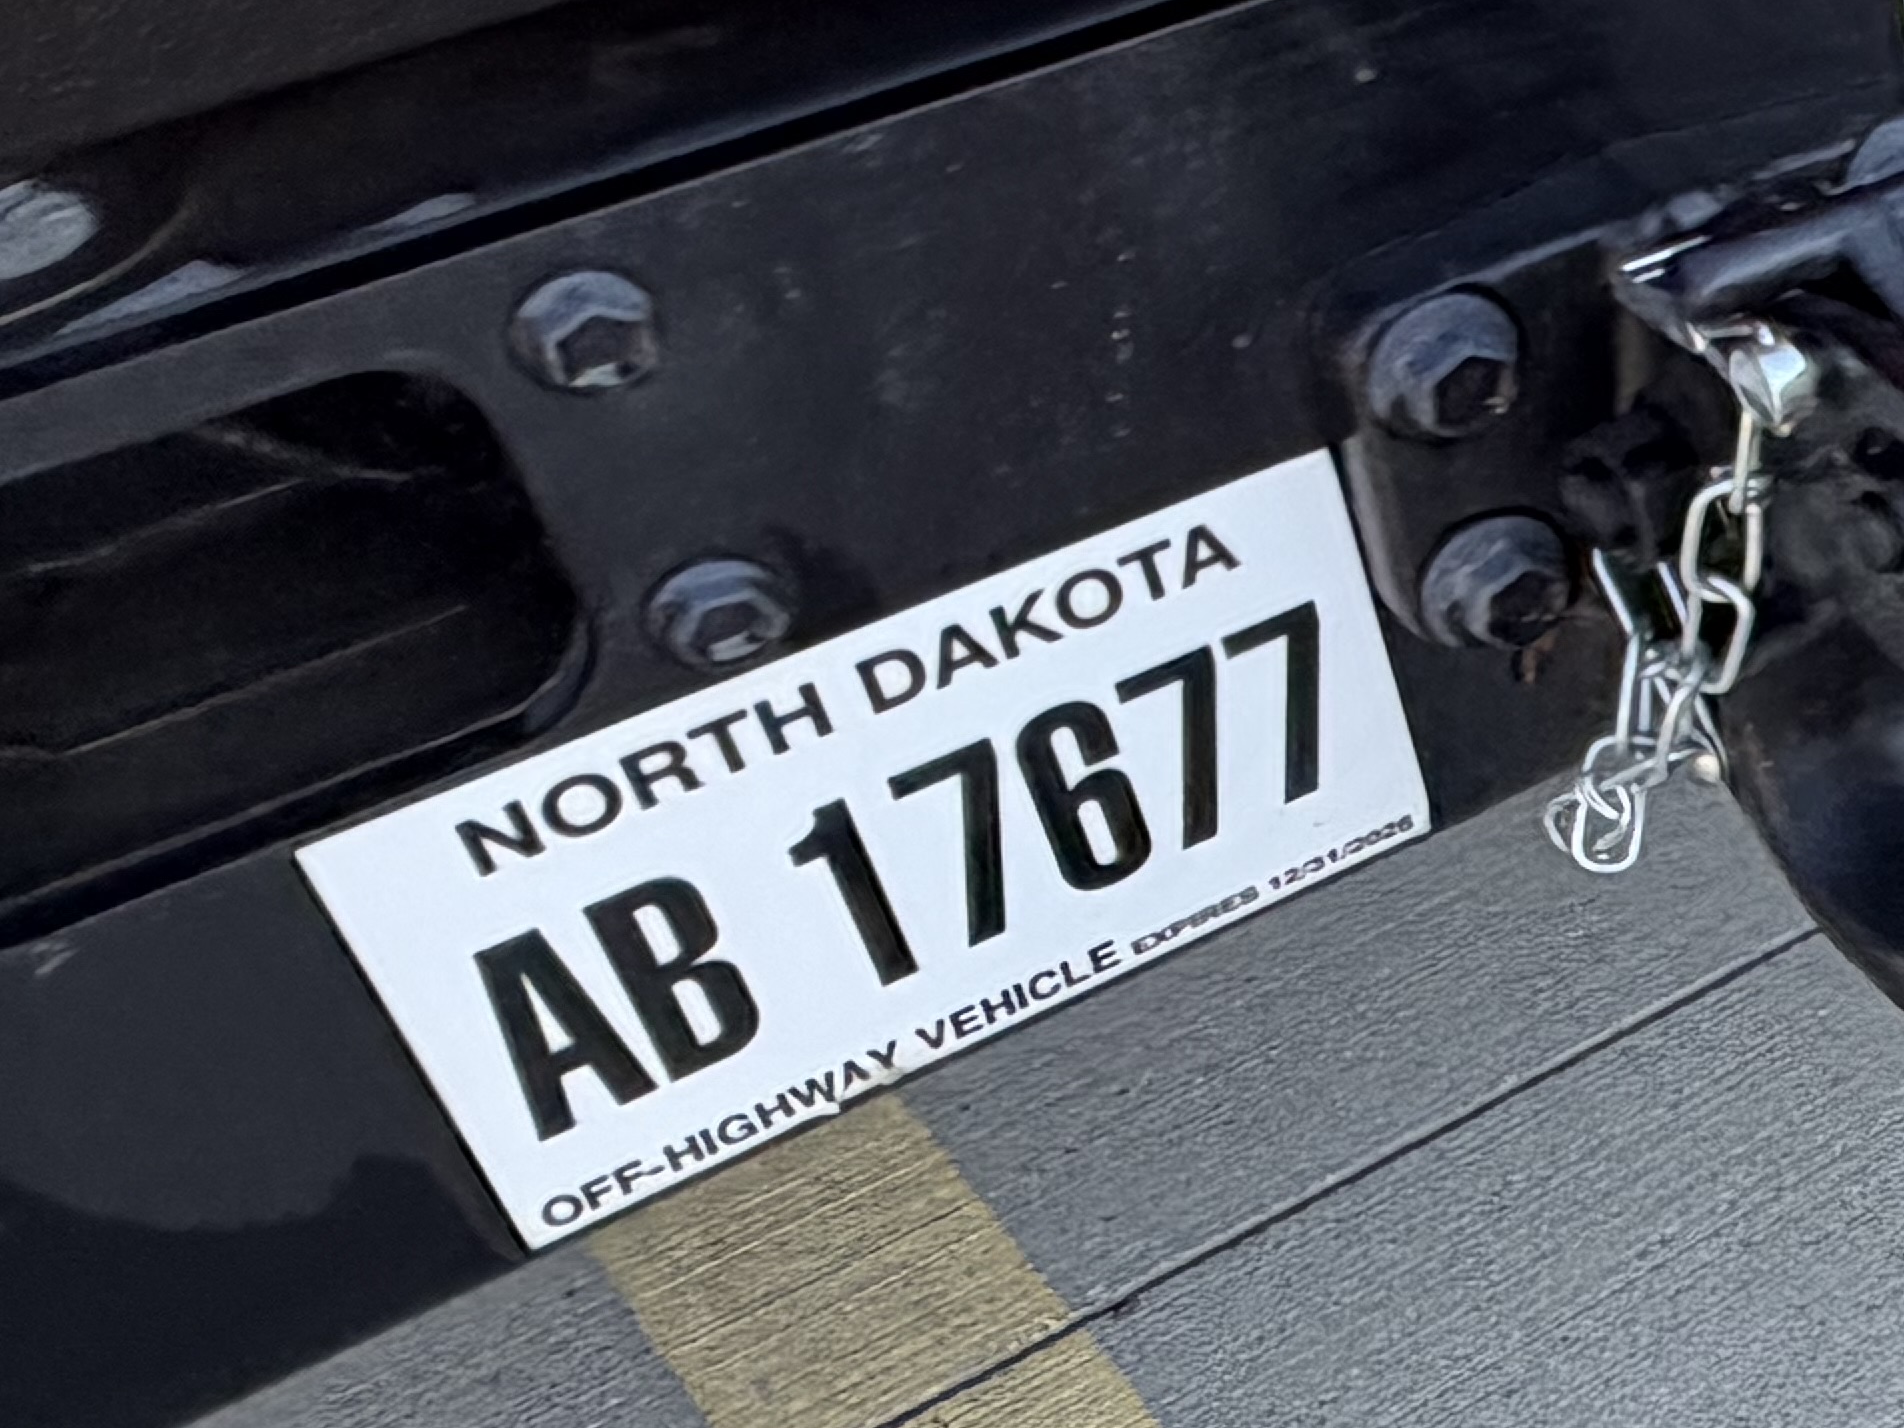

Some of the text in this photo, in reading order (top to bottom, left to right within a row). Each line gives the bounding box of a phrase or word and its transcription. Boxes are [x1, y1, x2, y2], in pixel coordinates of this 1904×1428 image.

[456, 525, 1241, 876] NORTH DAKOTA
[473, 601, 1319, 1142] AB 17677
[541, 1040, 898, 1228] OFF-HIGHWAY
[915, 939, 1118, 1050] VEHICLE
[1130, 885, 1259, 955] EXPIRES
